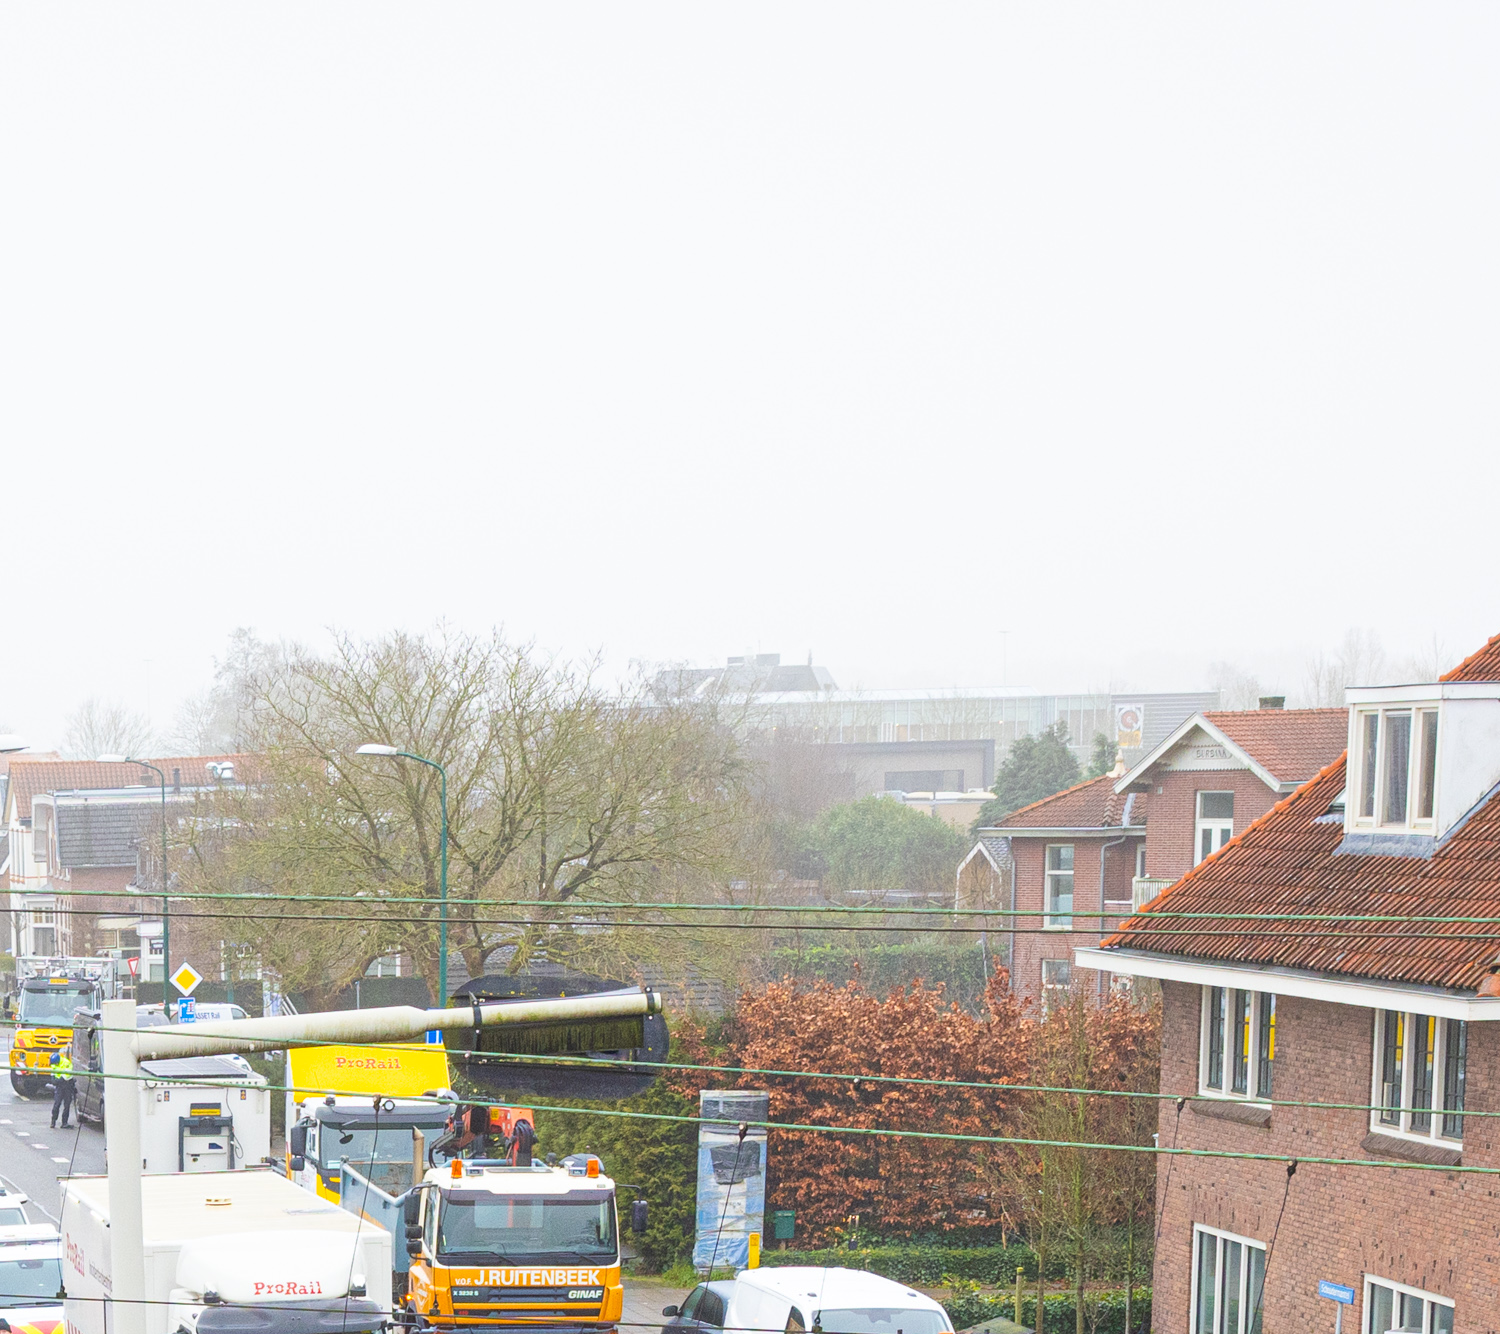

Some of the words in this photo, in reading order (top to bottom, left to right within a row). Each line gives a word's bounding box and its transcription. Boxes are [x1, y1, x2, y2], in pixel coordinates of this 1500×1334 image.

[335, 1057, 401, 1069] ProRail
[474, 1269, 600, 1286] J.RUITENBEEK
[253, 1281, 322, 1296] ProRail
[568, 1290, 603, 1299] GINAF
